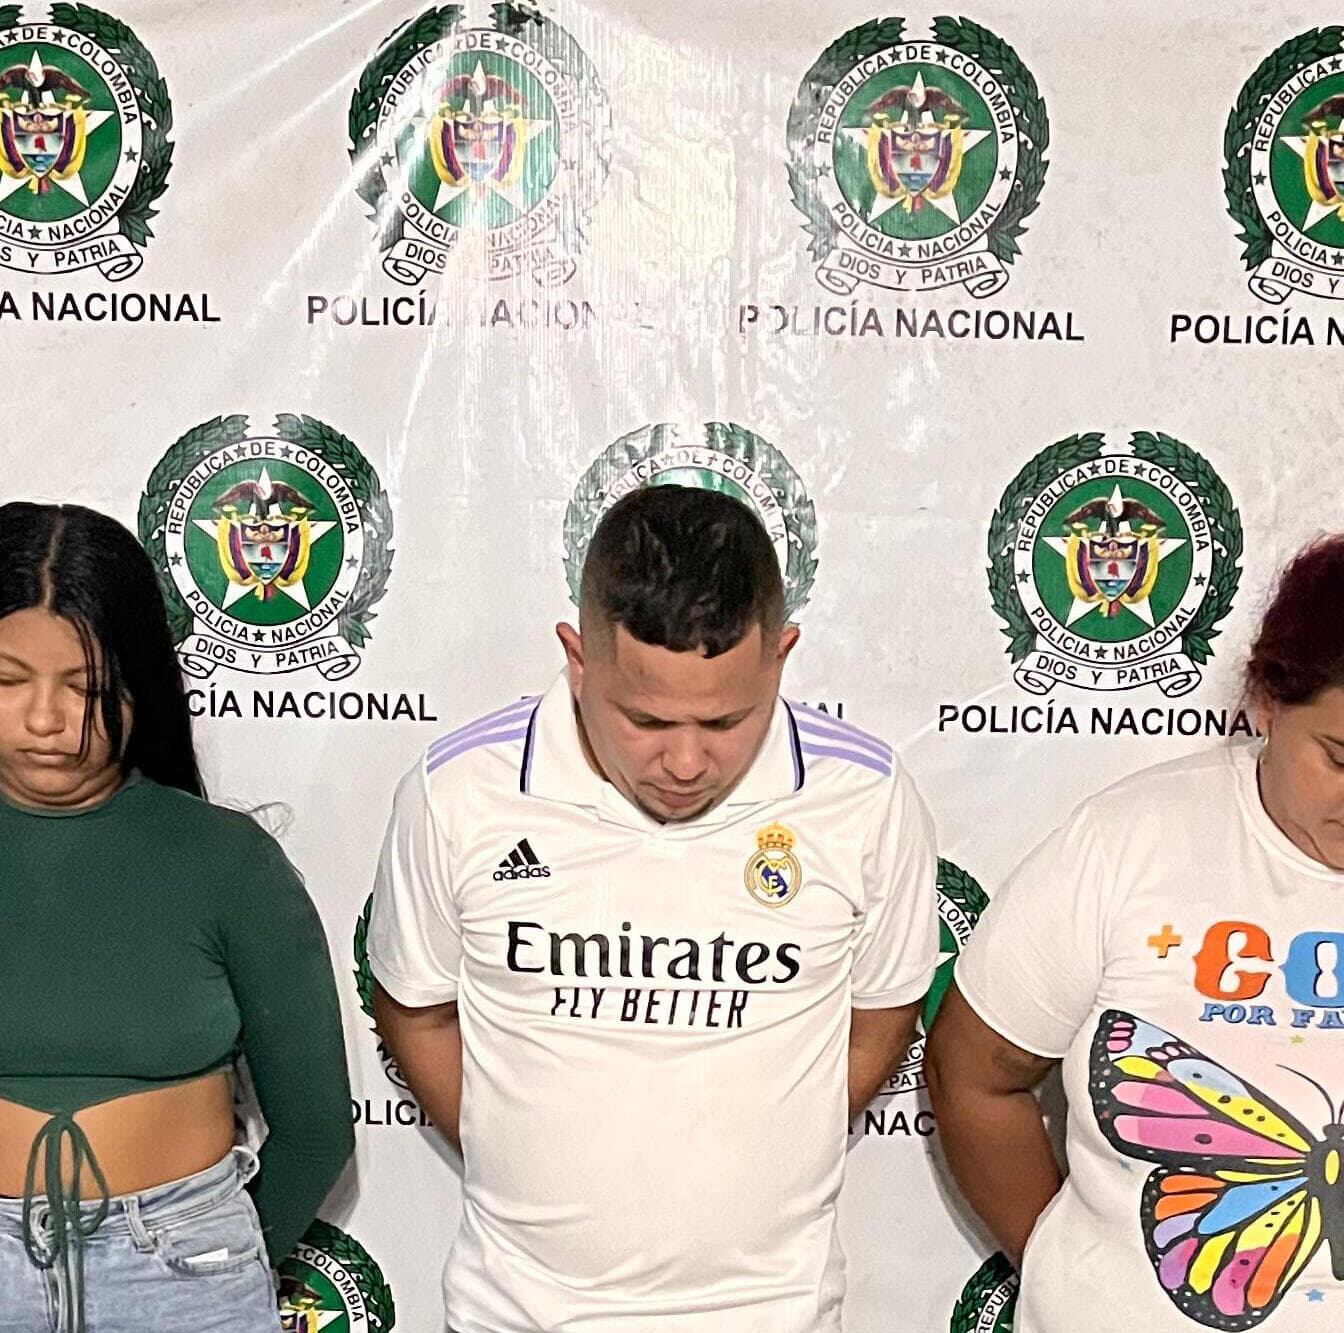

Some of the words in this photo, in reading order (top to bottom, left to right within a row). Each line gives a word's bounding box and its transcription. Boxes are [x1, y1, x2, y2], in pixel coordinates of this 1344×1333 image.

[22, 27, 47, 40] DE
[68, 31, 137, 124] COLOMBIA
[1255, 65, 1328, 151] REPUBLICA
[48, 183, 129, 241] NACIONAL
[28, 251, 40, 267] Y
[55, 239, 121, 267] PATRIA
[1267, 212, 1327, 264] POLICIA
[1272, 262, 1313, 287] DIOS
[1329, 278, 1339, 293] Y
[32, 292, 221, 321] NACIONAL
[896, 309, 1084, 340] NACIONAL
[1171, 308, 1314, 345] POLICÍA
[1018, 470, 1088, 551] REPUBLICA
[1105, 459, 1129, 473] DE
[1148, 465, 1209, 551] COLOMBIA
[1031, 608, 1090, 657] POLICIA
[1114, 605, 1195, 660] NACIONAL
[1036, 655, 1076, 679] DIOS
[1092, 670, 1102, 684] Y
[1118, 657, 1181, 684] PATRIA
[254, 691, 437, 721] NACIONAL
[939, 699, 1079, 734] POLICÍA
[1090, 707, 1262, 739] NACIONA
[493, 864, 551, 881] adidas
[506, 921, 801, 984] Emirates
[551, 987, 605, 1019] FLY
[1199, 1003, 1277, 1026] POR
